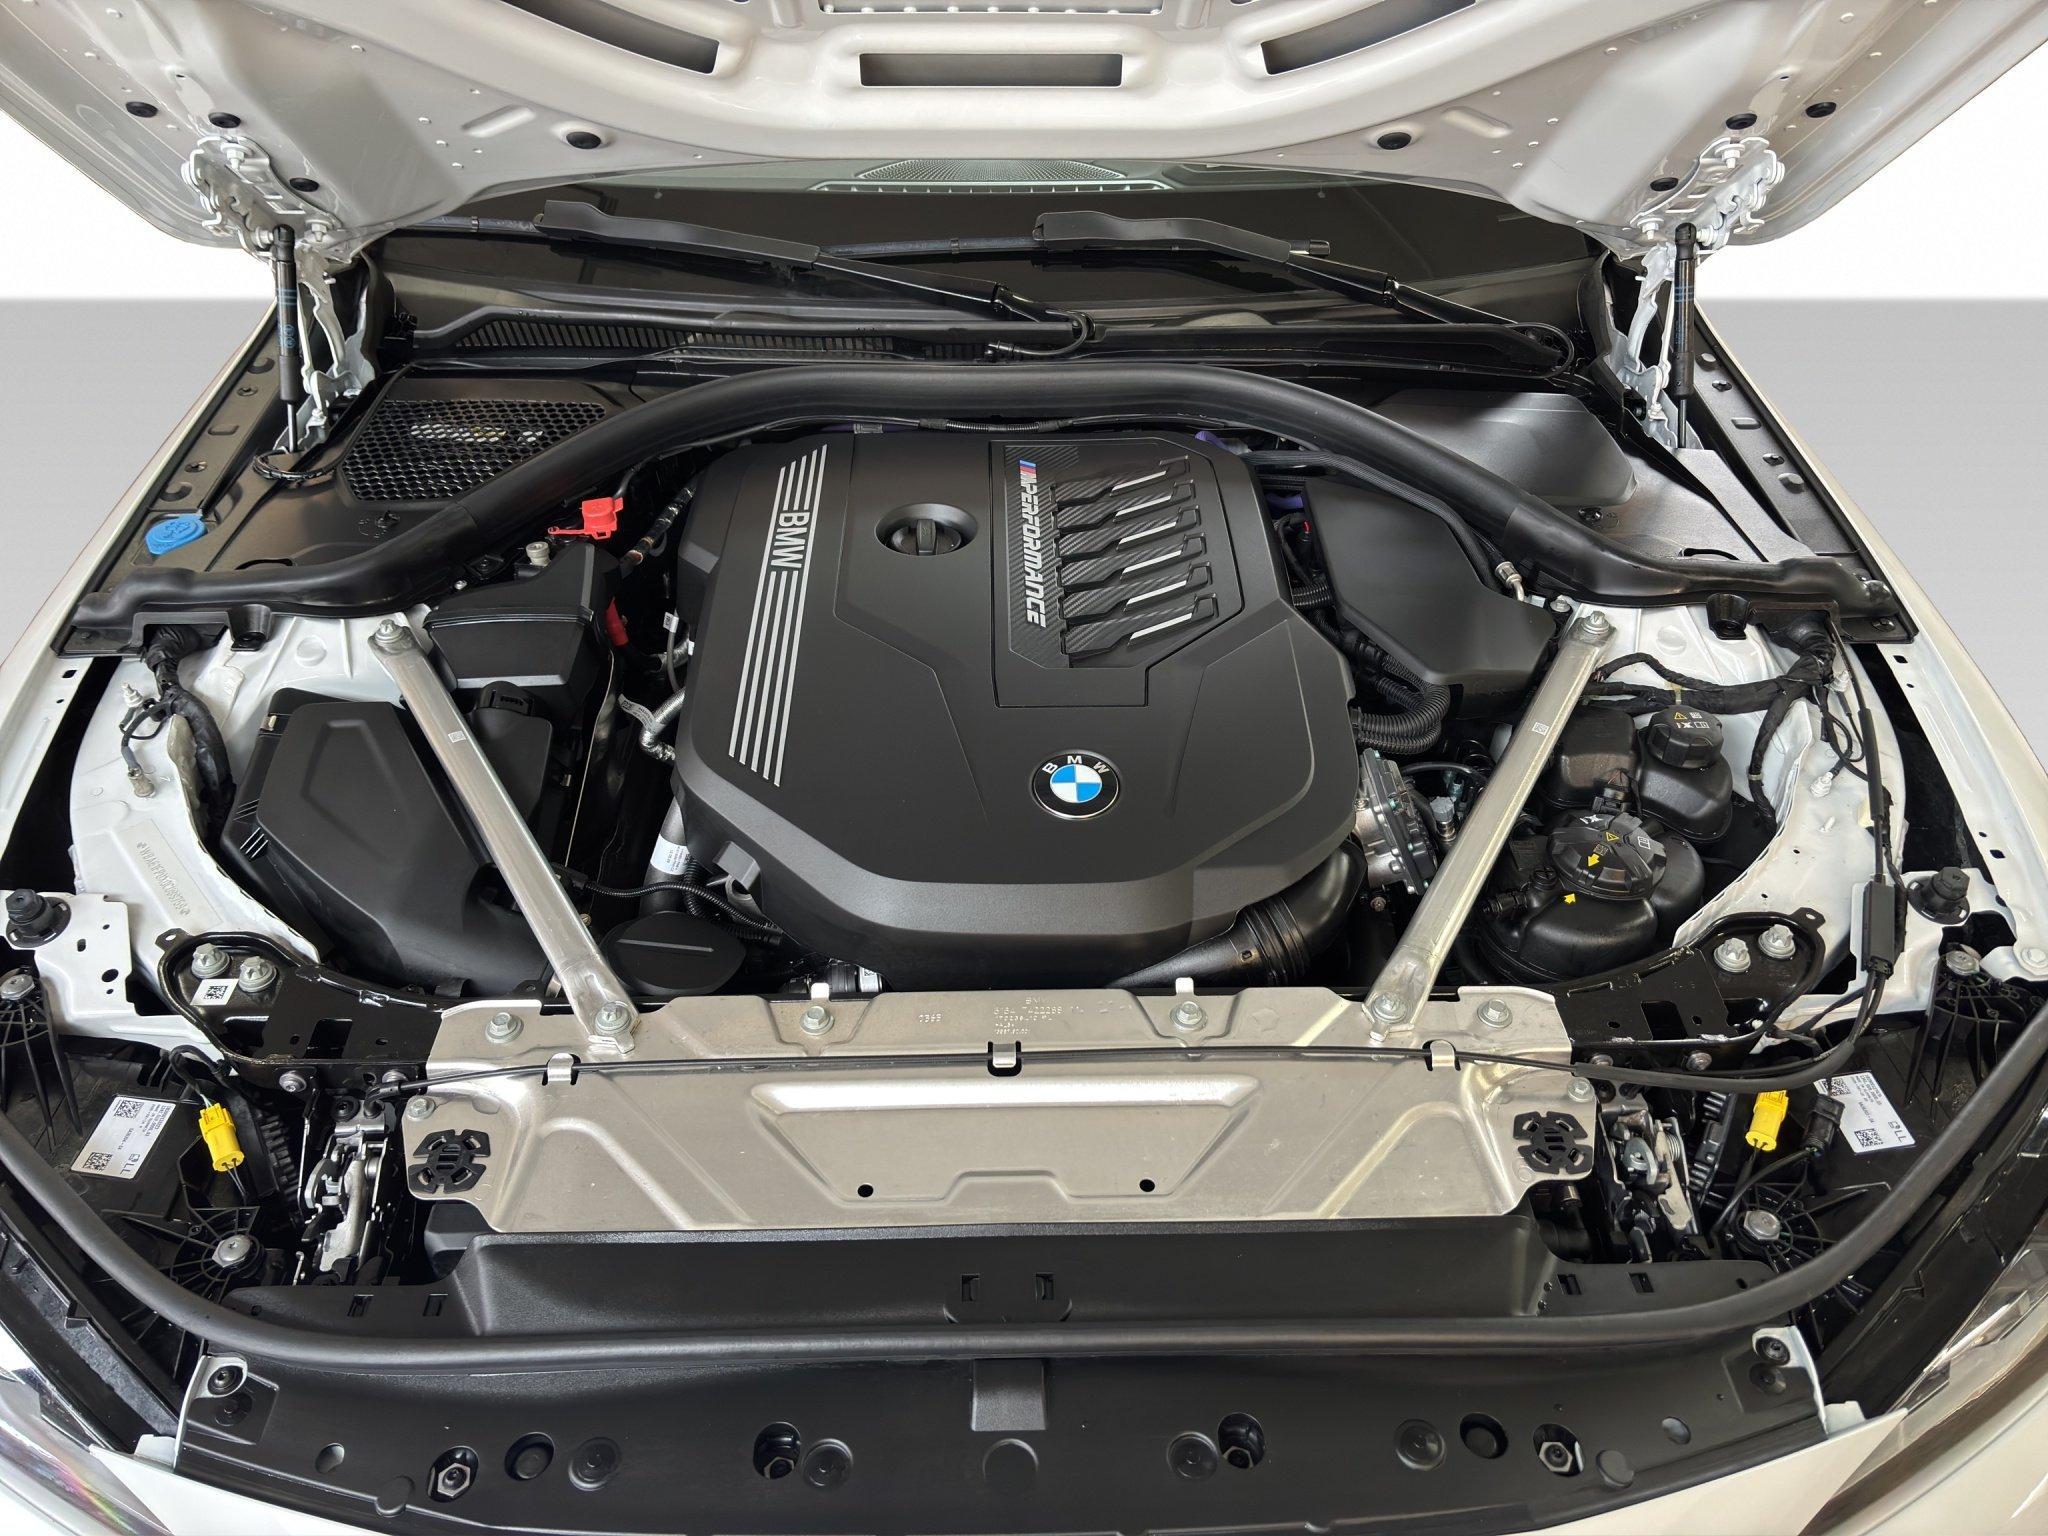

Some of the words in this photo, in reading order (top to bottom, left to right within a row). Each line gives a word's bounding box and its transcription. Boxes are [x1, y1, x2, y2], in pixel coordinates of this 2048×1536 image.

[771, 511, 811, 568] BMW
[1020, 483, 1047, 628] PERFORMANCE
[1041, 755, 1110, 774] BMW
